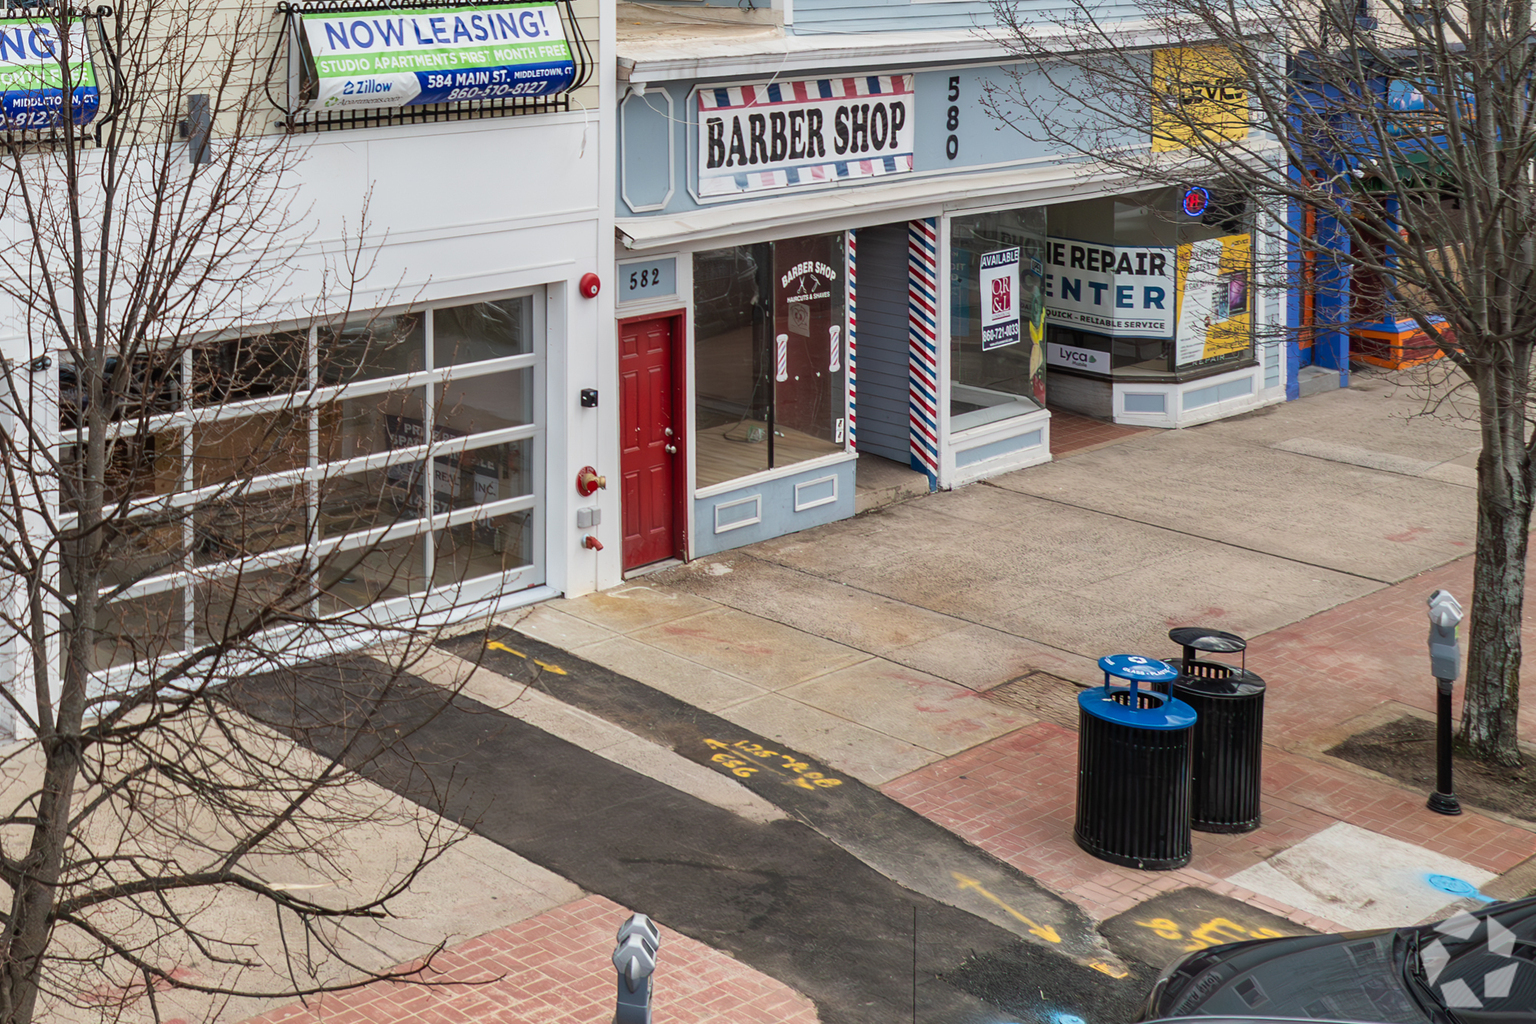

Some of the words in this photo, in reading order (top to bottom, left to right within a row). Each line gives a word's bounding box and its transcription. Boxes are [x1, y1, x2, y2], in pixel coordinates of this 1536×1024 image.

[324, 18, 404, 50] NOW
[411, 10, 550, 45] LEASING!
[320, 57, 370, 74] STUDIO
[374, 51, 457, 70] APARTMENTS
[457, 50, 491, 64] FIRST
[493, 47, 536, 61] MONTH
[538, 43, 568, 58] FREE
[356, 79, 392, 95] Zillow
[427, 73, 453, 89] 584
[455, 71, 490, 87] MAIN
[492, 69, 511, 83] ST.
[513, 66, 563, 80] MIDDLETOWN,
[564, 66, 573, 75] CT
[83, 93, 94, 104] CT
[706, 108, 827, 169] BARBER
[833, 100, 906, 155] SHOP
[981, 249, 1019, 267] AVAILABLE
[1070, 245, 1166, 277] REPAIR
[629, 268, 660, 291] 582
[781, 260, 814, 288] BARBER
[814, 261, 837, 281] SHOP
[786, 294, 809, 304] HAIRCUTS
[813, 290, 831, 299] SHAVES
[1045, 308, 1073, 320] QUICK
[1080, 314, 1122, 328] RELIABLE
[1124, 321, 1166, 330] SERVICE
[982, 321, 1019, 344] 860-721-0033
[1059, 347, 1088, 364] Lyca
[1071, 360, 1088, 368] Mobile
